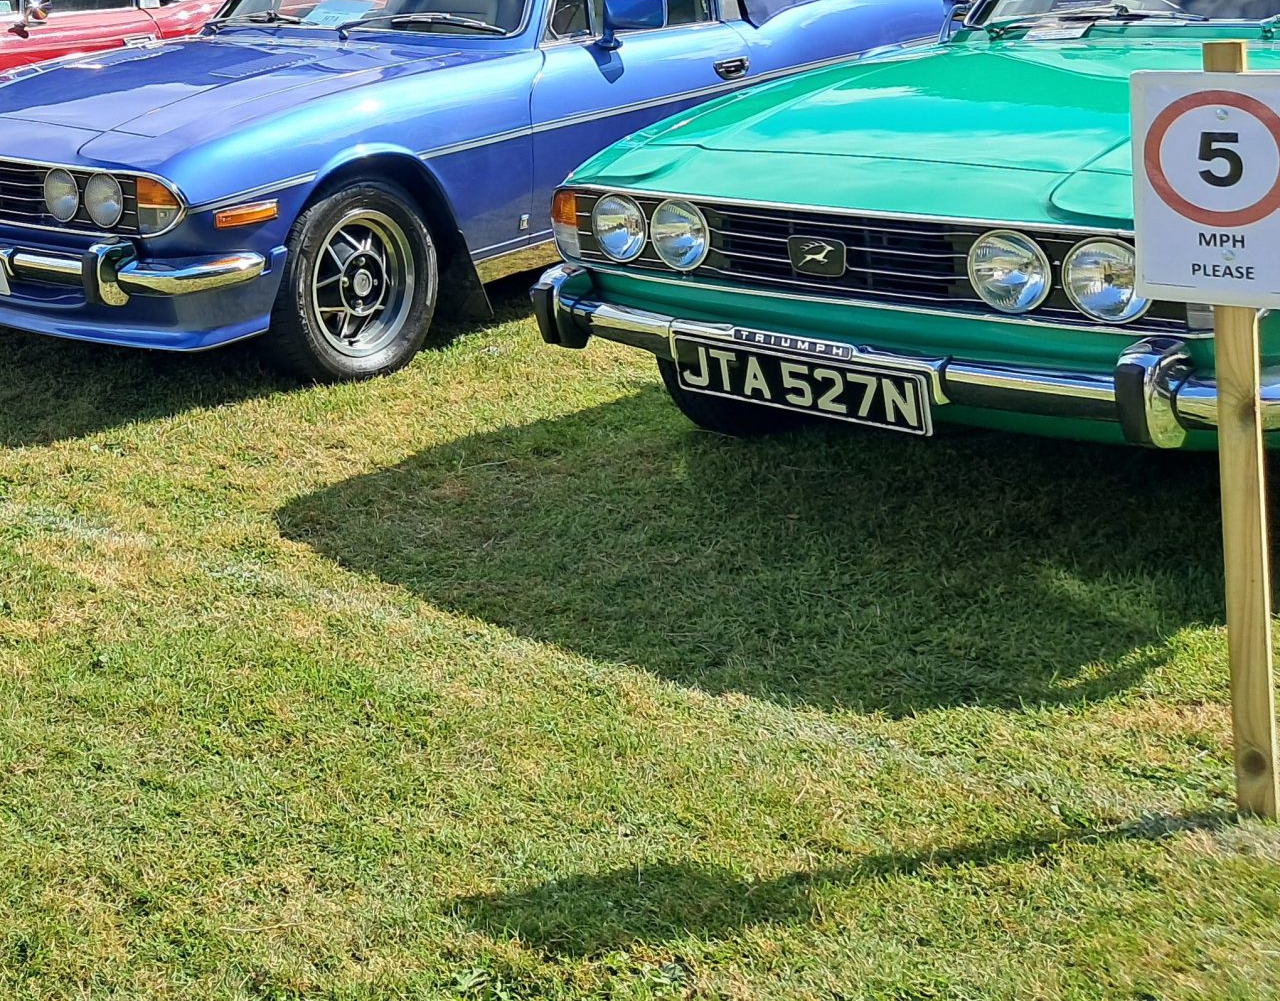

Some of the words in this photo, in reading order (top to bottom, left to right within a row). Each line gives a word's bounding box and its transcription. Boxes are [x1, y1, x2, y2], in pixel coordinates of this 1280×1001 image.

[1198, 131, 1244, 188] 5
[1198, 232, 1245, 249] MPH
[1191, 263, 1255, 280] PLEASE
[740, 331, 844, 356] TRIUMPH
[683, 346, 771, 399] JTA
[779, 361, 918, 426] 527N
